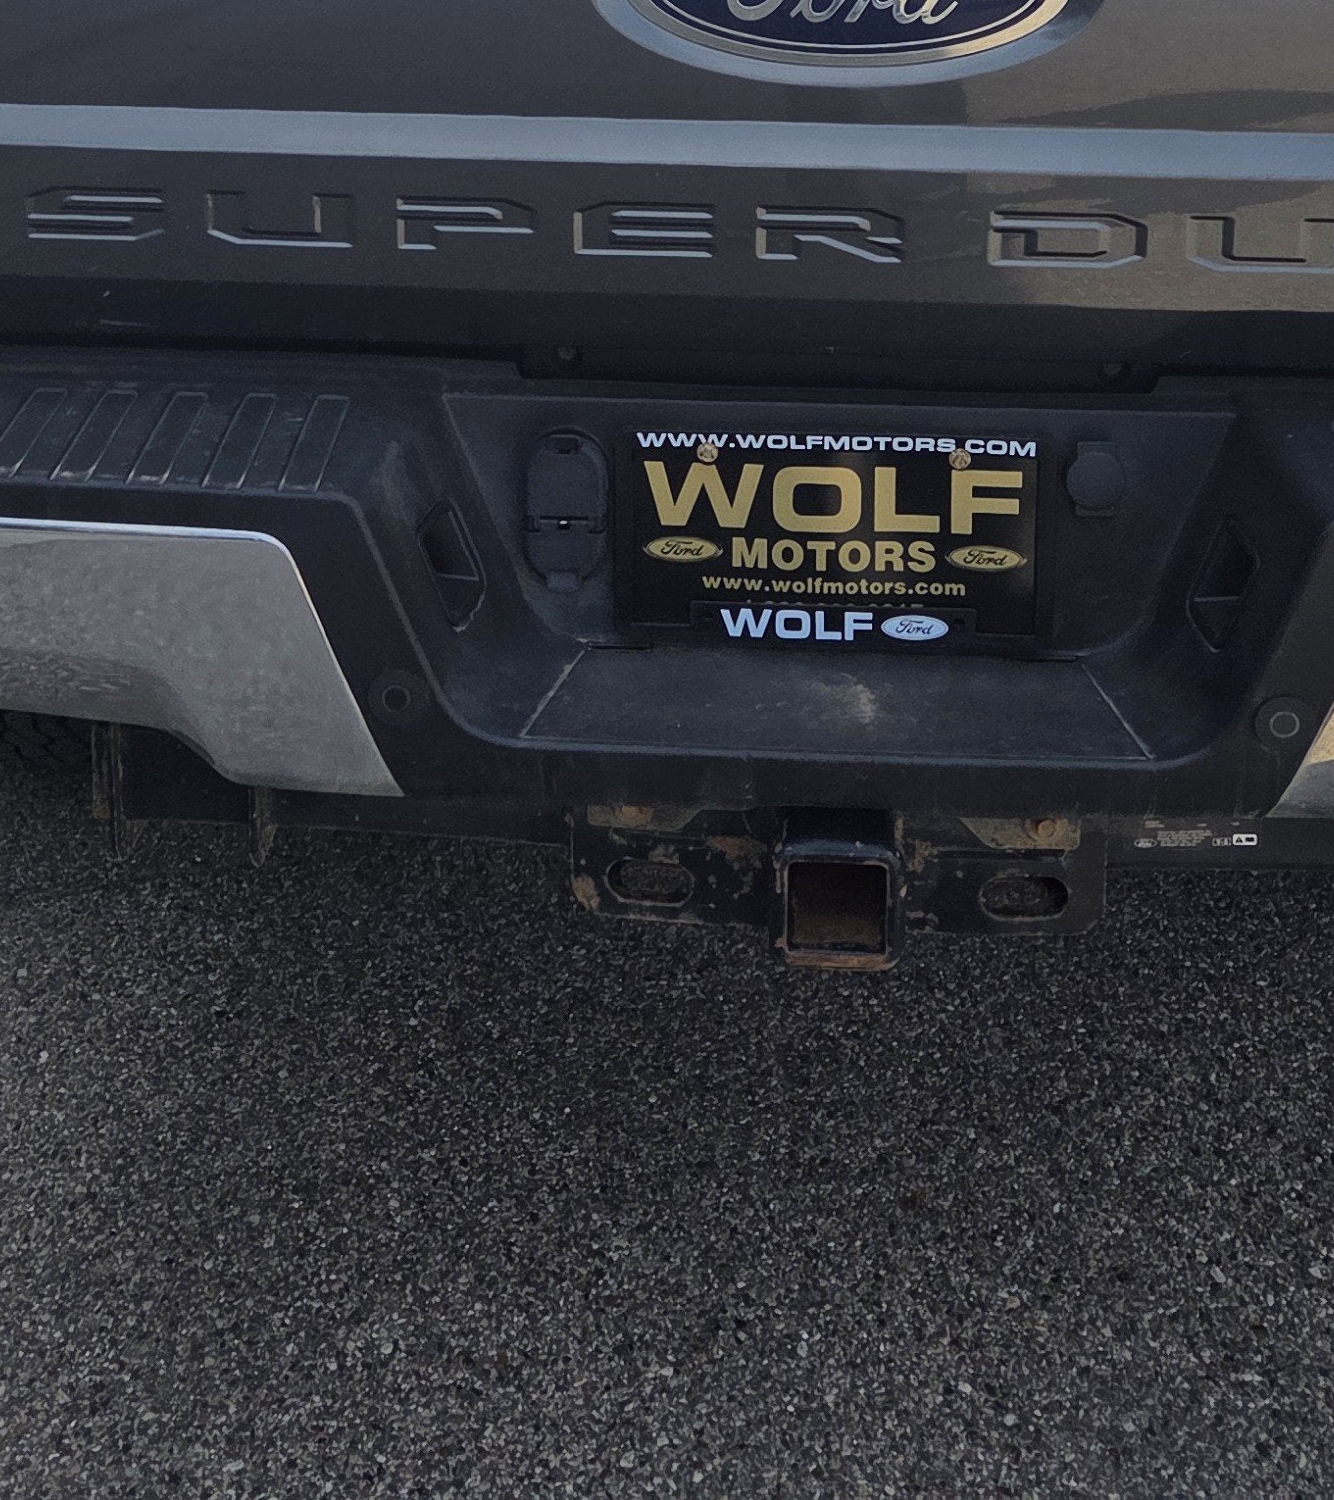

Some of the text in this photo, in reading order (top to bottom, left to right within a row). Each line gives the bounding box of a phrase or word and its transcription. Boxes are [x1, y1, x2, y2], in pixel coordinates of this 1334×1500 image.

[25, 185, 905, 263] SUPER
[636, 431, 1037, 458] WWW.WOLFMOTORSCOM
[643, 460, 1023, 535] WOLF
[660, 536, 1008, 574] Ford MOTORS Ford
[701, 575, 967, 597] www.wolfmotors.com
[720, 608, 934, 642] WOLF Ford
